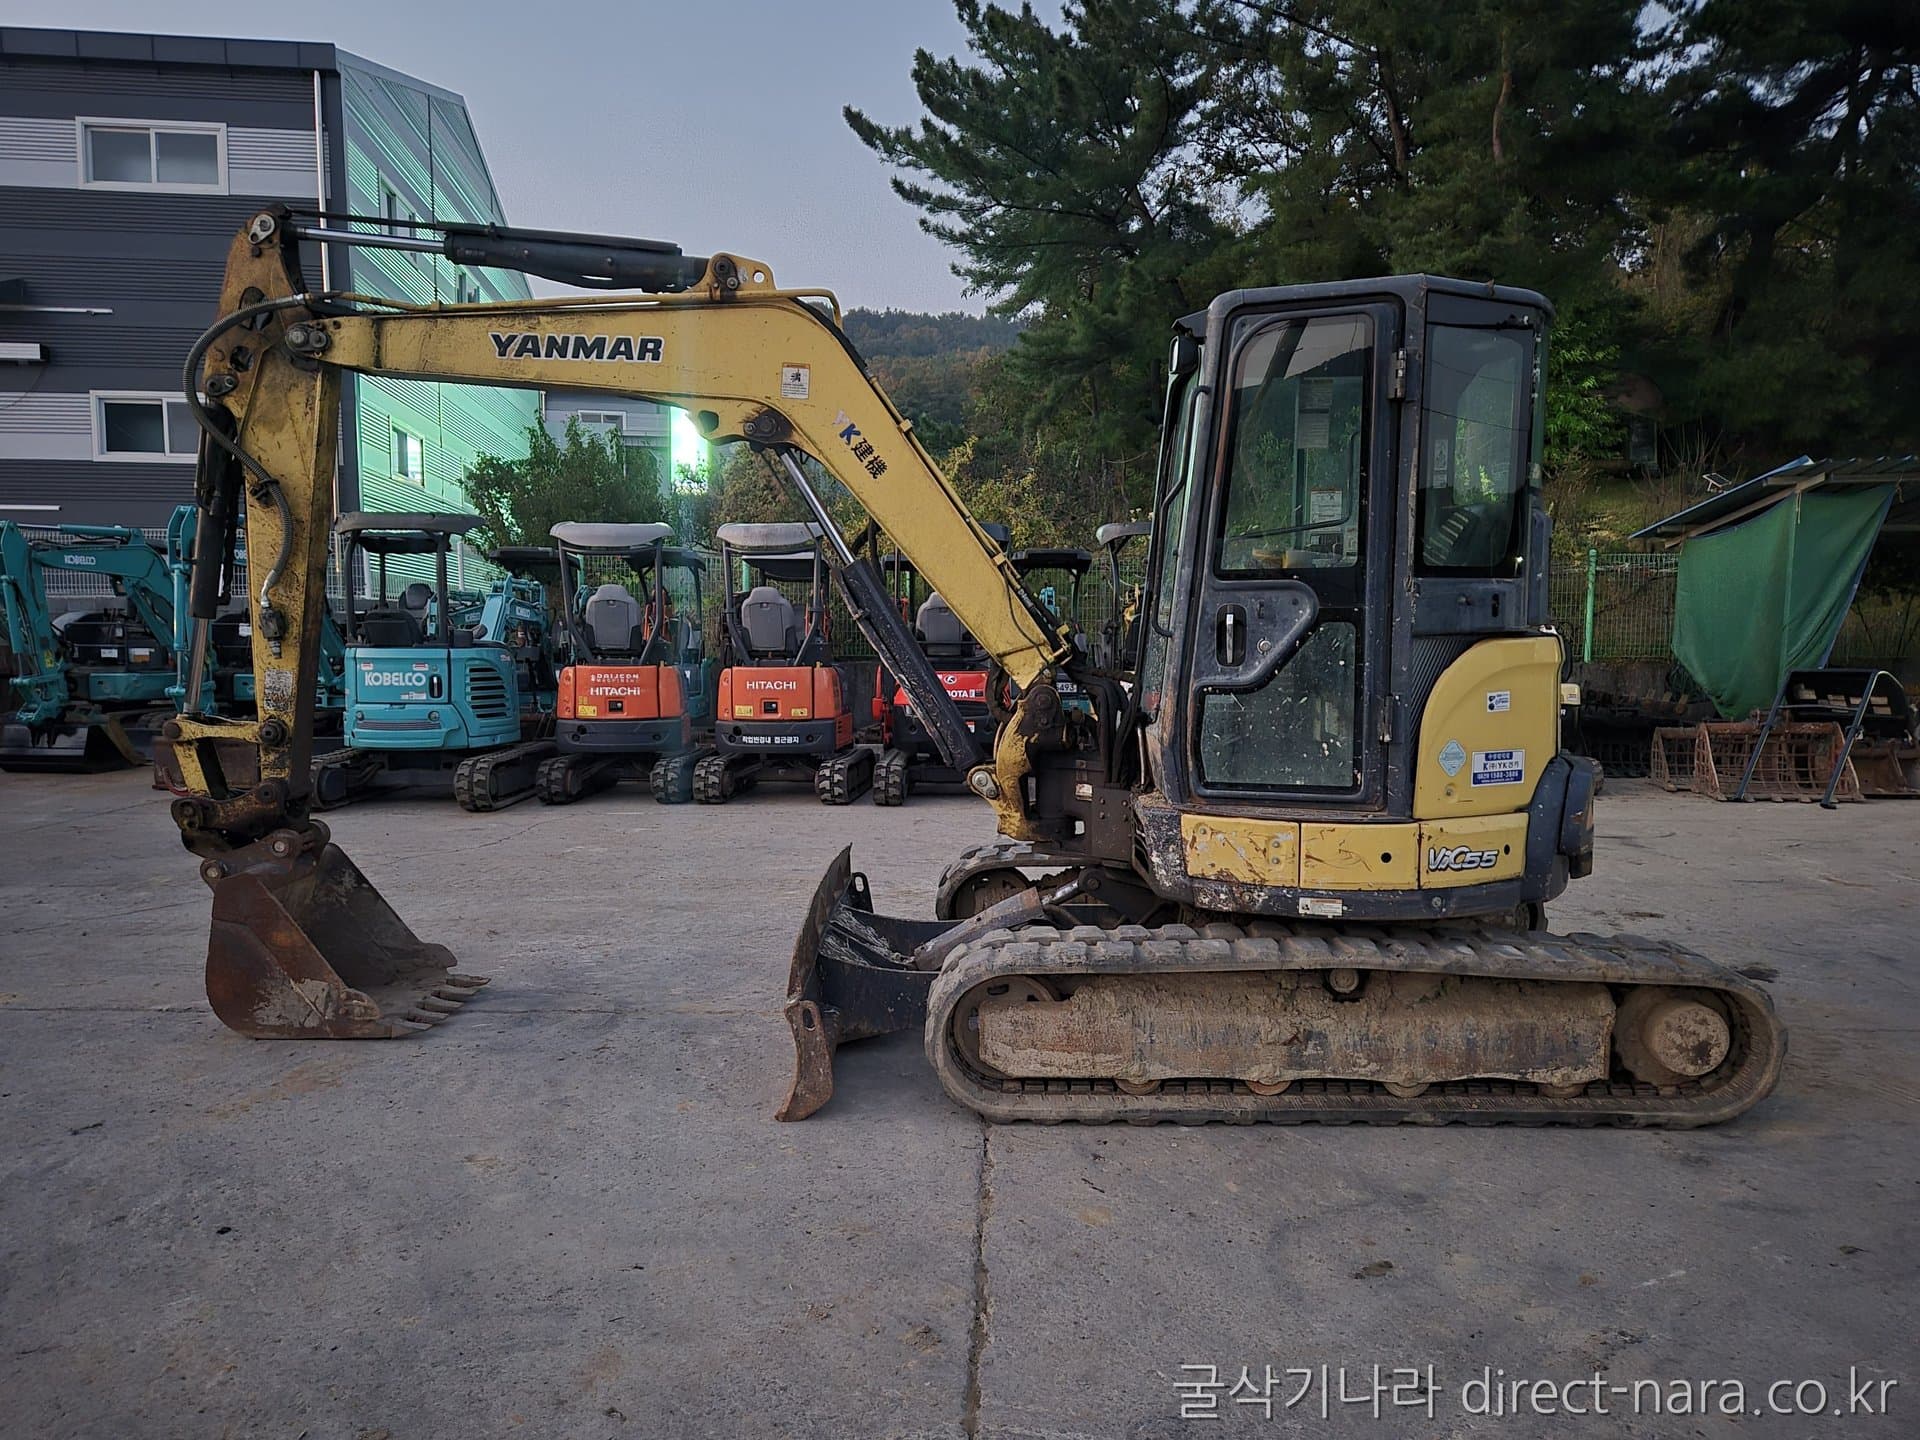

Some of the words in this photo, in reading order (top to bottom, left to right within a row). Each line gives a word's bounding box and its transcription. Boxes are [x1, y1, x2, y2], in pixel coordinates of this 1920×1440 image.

[489, 332, 664, 362] YANMAR
[364, 672, 426, 686] KOBELCO
[590, 686, 641, 696] HITACHI
[746, 681, 797, 690] HITACHI
